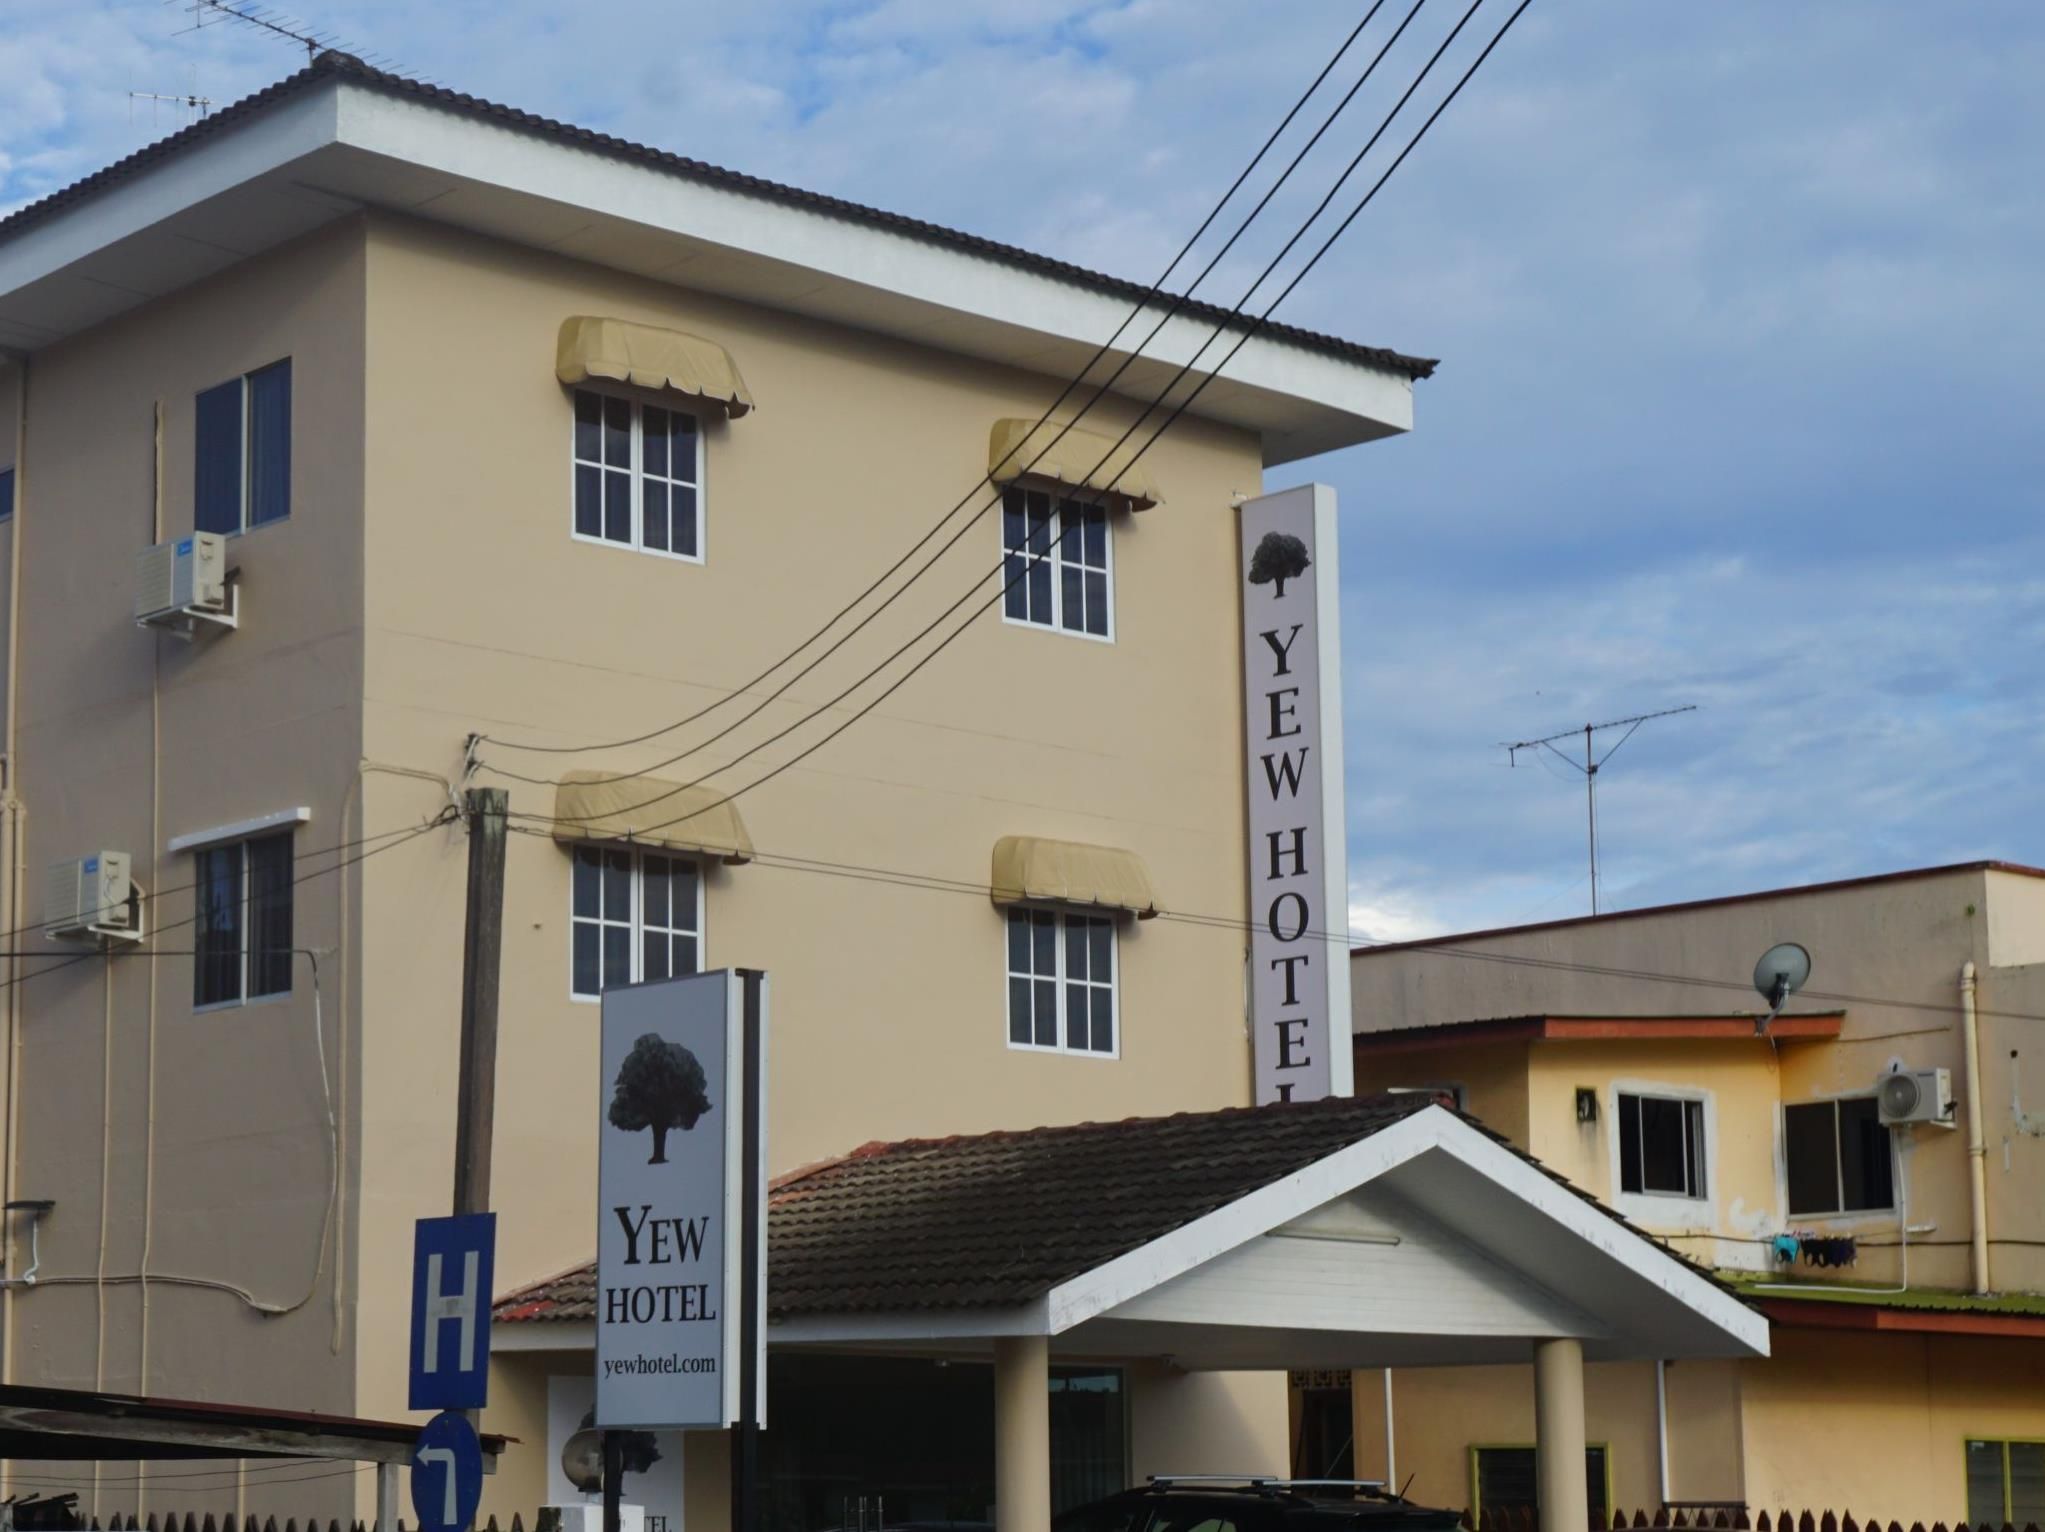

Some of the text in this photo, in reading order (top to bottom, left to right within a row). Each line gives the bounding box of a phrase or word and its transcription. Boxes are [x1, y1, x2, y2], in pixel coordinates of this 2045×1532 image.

[1259, 624, 1309, 801] YEW
[423, 1251, 479, 1373] H
[605, 1284, 716, 1323] HOTEL
[604, 1353, 716, 1379] yewhotel.com
